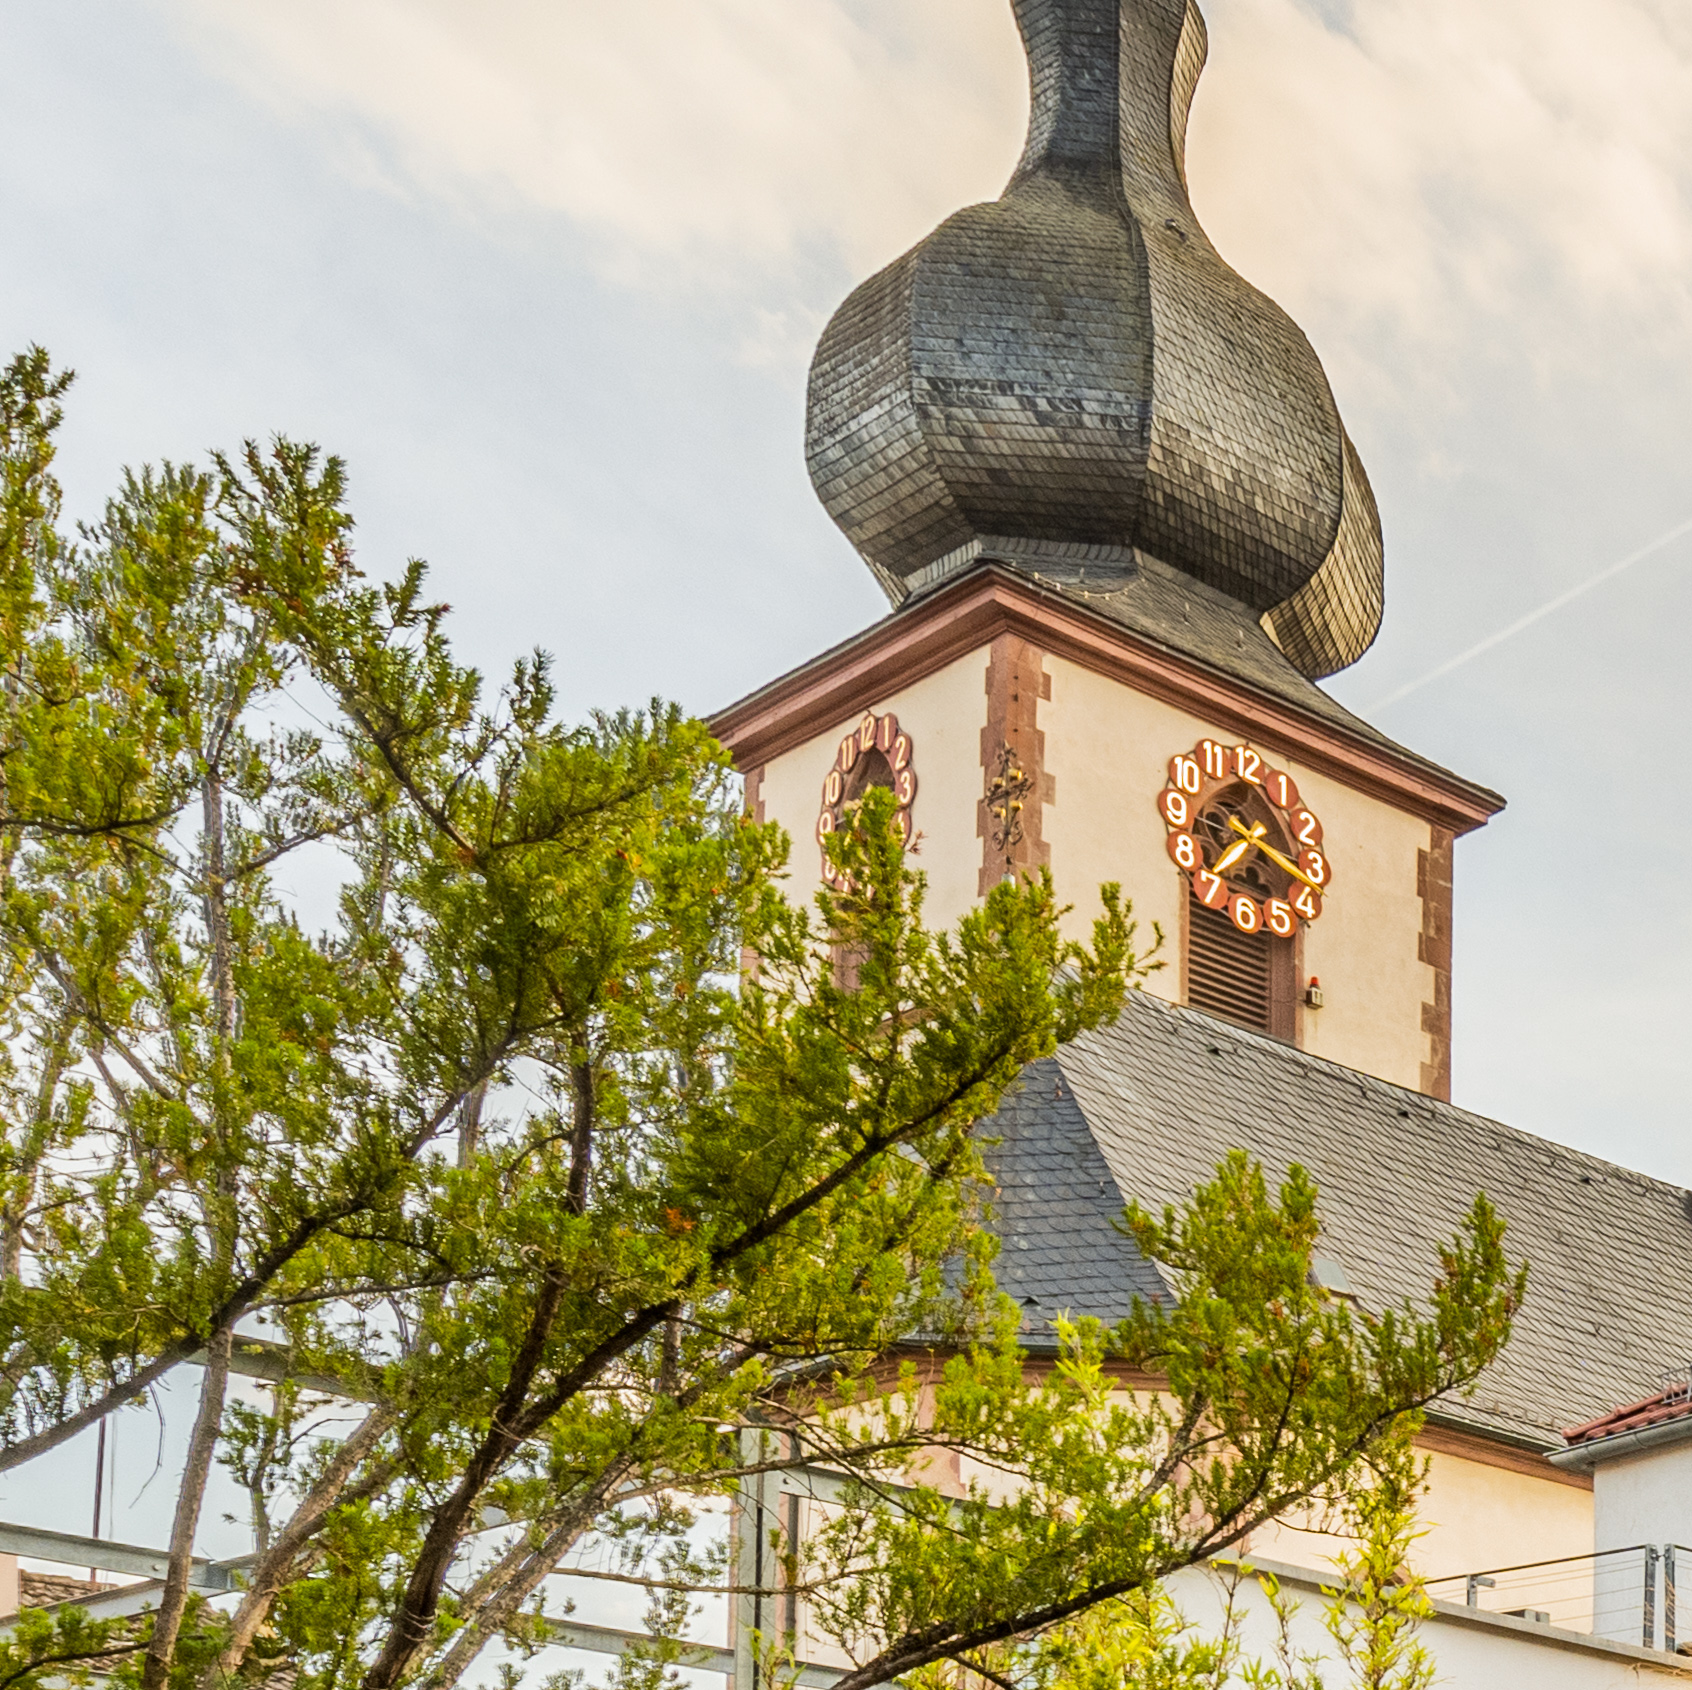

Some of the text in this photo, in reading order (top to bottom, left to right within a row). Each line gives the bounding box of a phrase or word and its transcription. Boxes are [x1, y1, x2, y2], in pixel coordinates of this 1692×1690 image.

[860, 715, 876, 750] 12
[883, 716, 890, 748] 1
[841, 738, 853, 769] 11
[895, 736, 906, 771] 2
[1202, 740, 1224, 778] 11
[1234, 745, 1262, 785] 12
[825, 771, 839, 805] 10
[899, 771, 911, 804] 3
[1173, 755, 1200, 795] 10
[1278, 775, 1288, 806] 1
[1166, 791, 1187, 826] 9
[1298, 811, 1316, 846] 2
[1175, 833, 1195, 868] 8
[1306, 851, 1324, 884] 3
[1200, 870, 1221, 905] 7
[1295, 886, 1316, 919] 4
[1236, 897, 1256, 930] 6
[1270, 900, 1291, 935] 5
